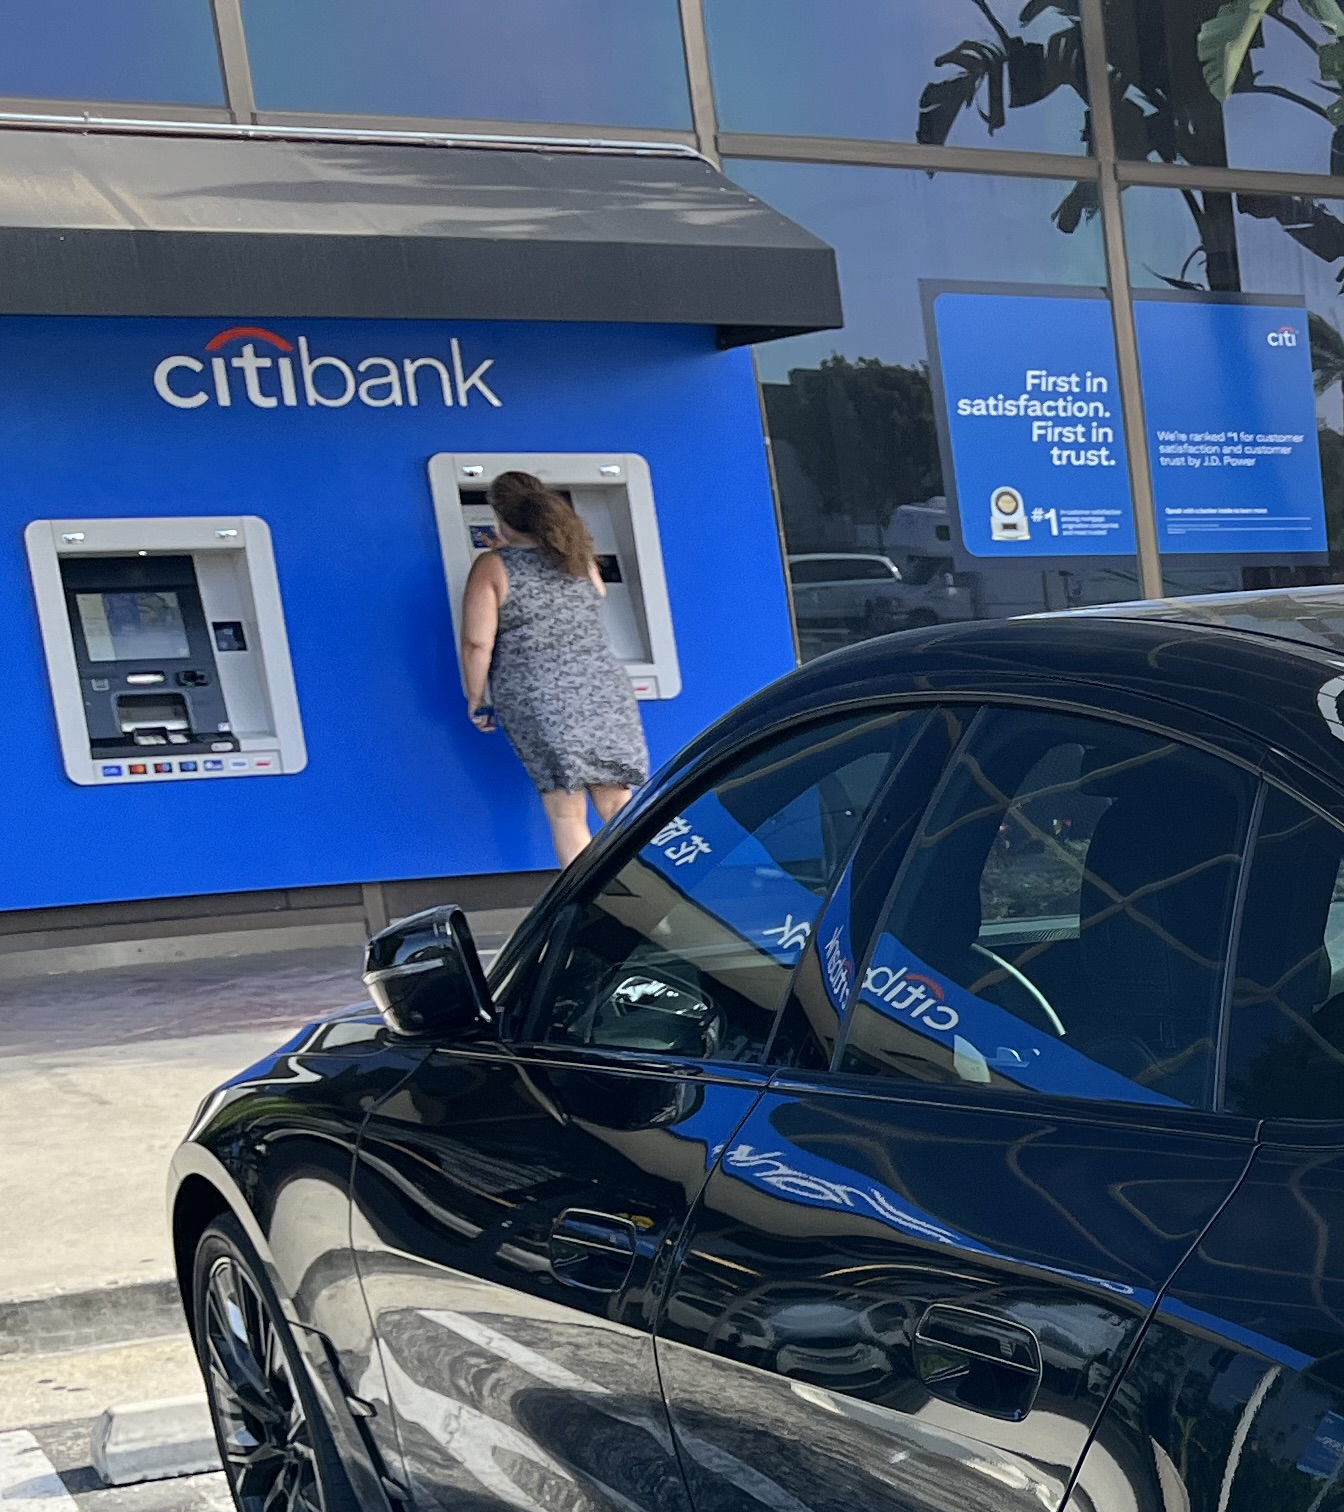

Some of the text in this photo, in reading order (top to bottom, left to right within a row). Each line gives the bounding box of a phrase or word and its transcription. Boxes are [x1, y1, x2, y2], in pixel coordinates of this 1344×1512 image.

[1267, 326, 1297, 347] citi
[153, 326, 503, 409] citibank
[1026, 369, 1108, 393] First in
[957, 393, 1111, 418] satisfaction.
[1031, 420, 1114, 443] First in
[1239, 432, 1254, 442] for
[1255, 433, 1304, 443] customer
[1050, 446, 1117, 467] trust.
[1159, 443, 1292, 455] satisfaction and customer
[1159, 456, 1186, 467] trust
[1187, 456, 1201, 468] by
[1223, 456, 1256, 467] Power
[1031, 507, 1059, 536] #1
